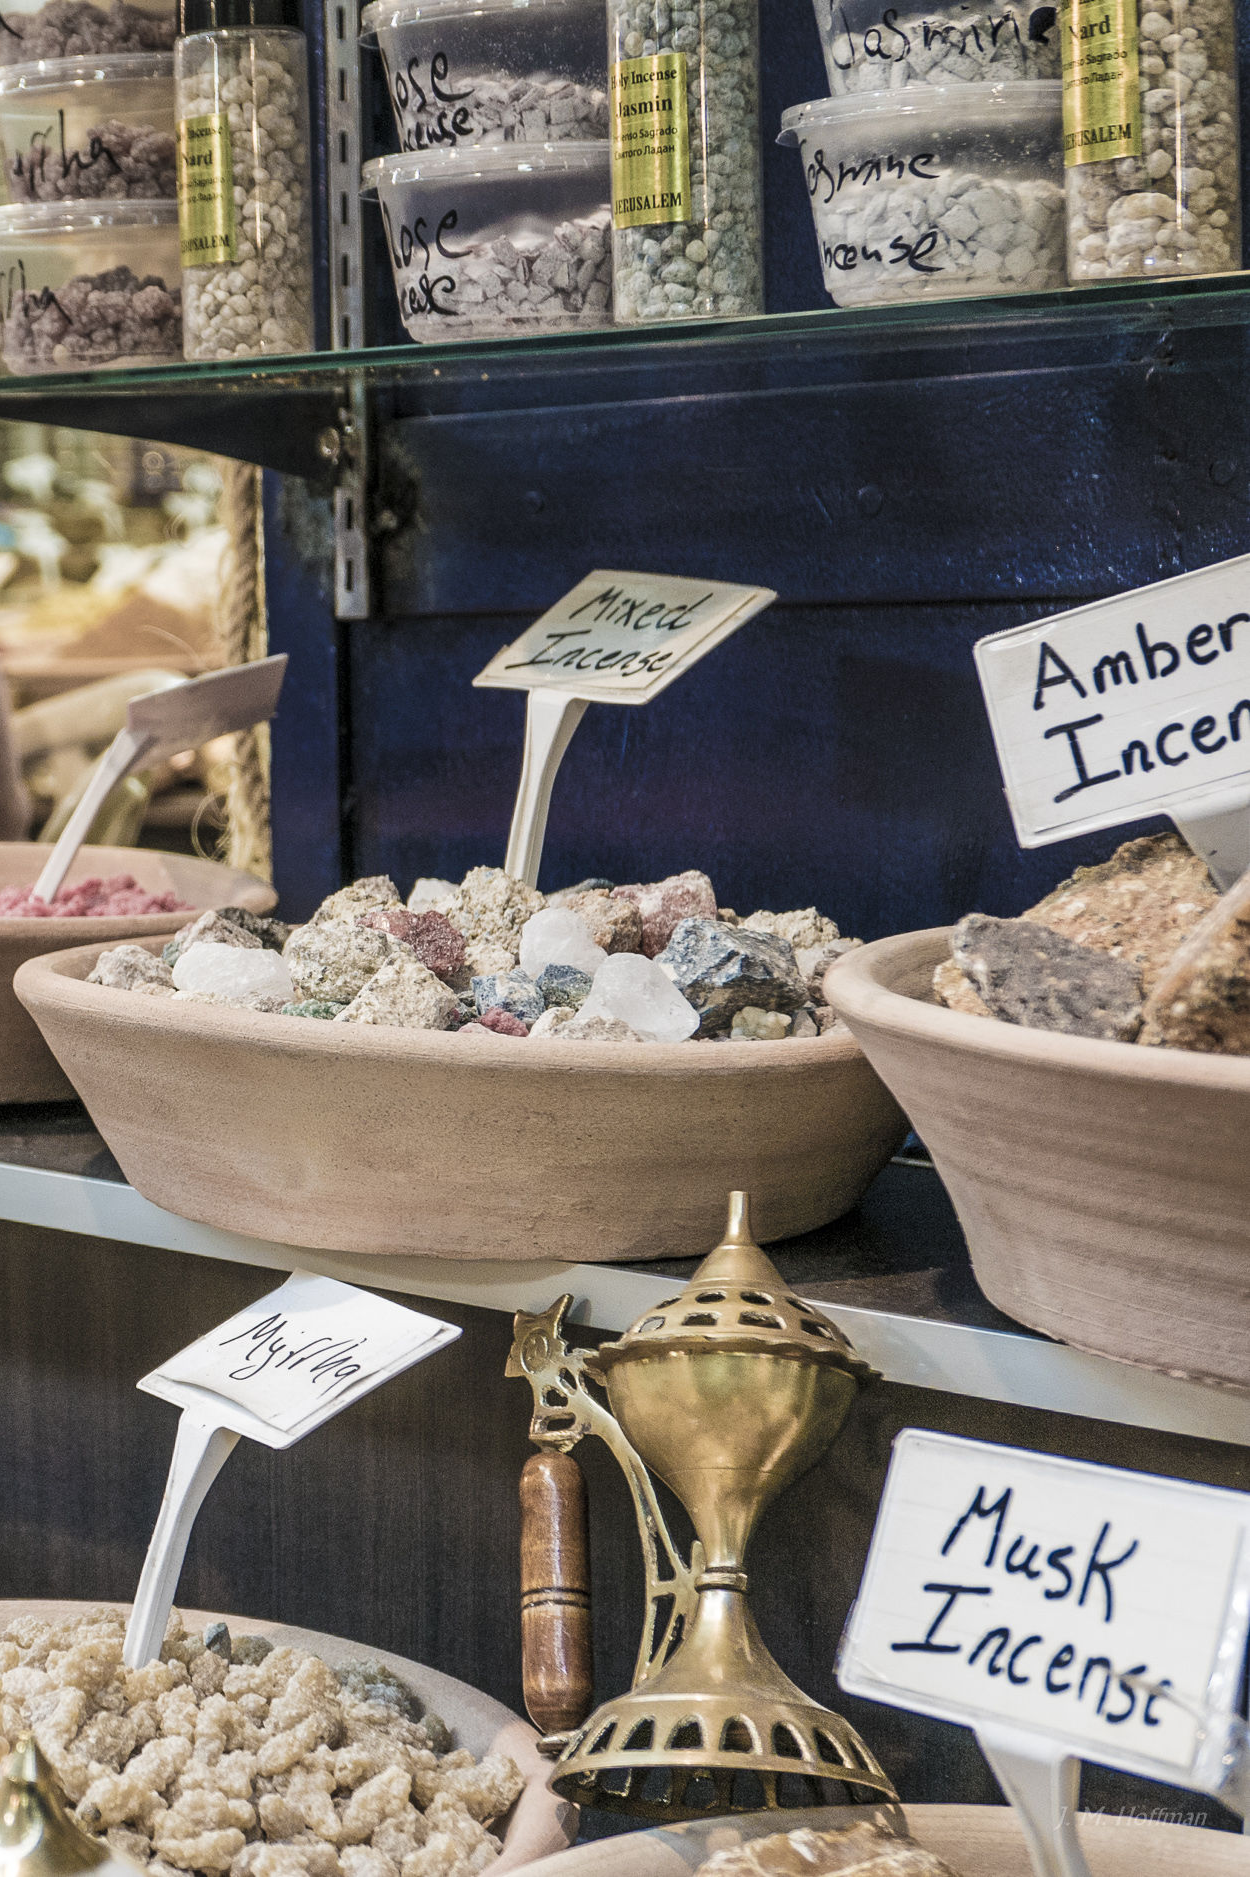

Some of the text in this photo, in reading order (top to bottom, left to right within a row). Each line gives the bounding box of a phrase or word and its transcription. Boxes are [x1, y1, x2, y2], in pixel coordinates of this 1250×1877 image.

[382, 51, 475, 113] ose
[611, 68, 677, 91] Hly Incense
[616, 95, 673, 118] Jasmin
[638, 125, 678, 140] Sagrado
[800, 138, 941, 204] asmine
[614, 191, 682, 215] JERUSALEM
[822, 230, 946, 273] ncense
[569, 585, 714, 631] Mixed
[504, 629, 674, 678] Incense
[1032, 611, 1250, 711] Amber
